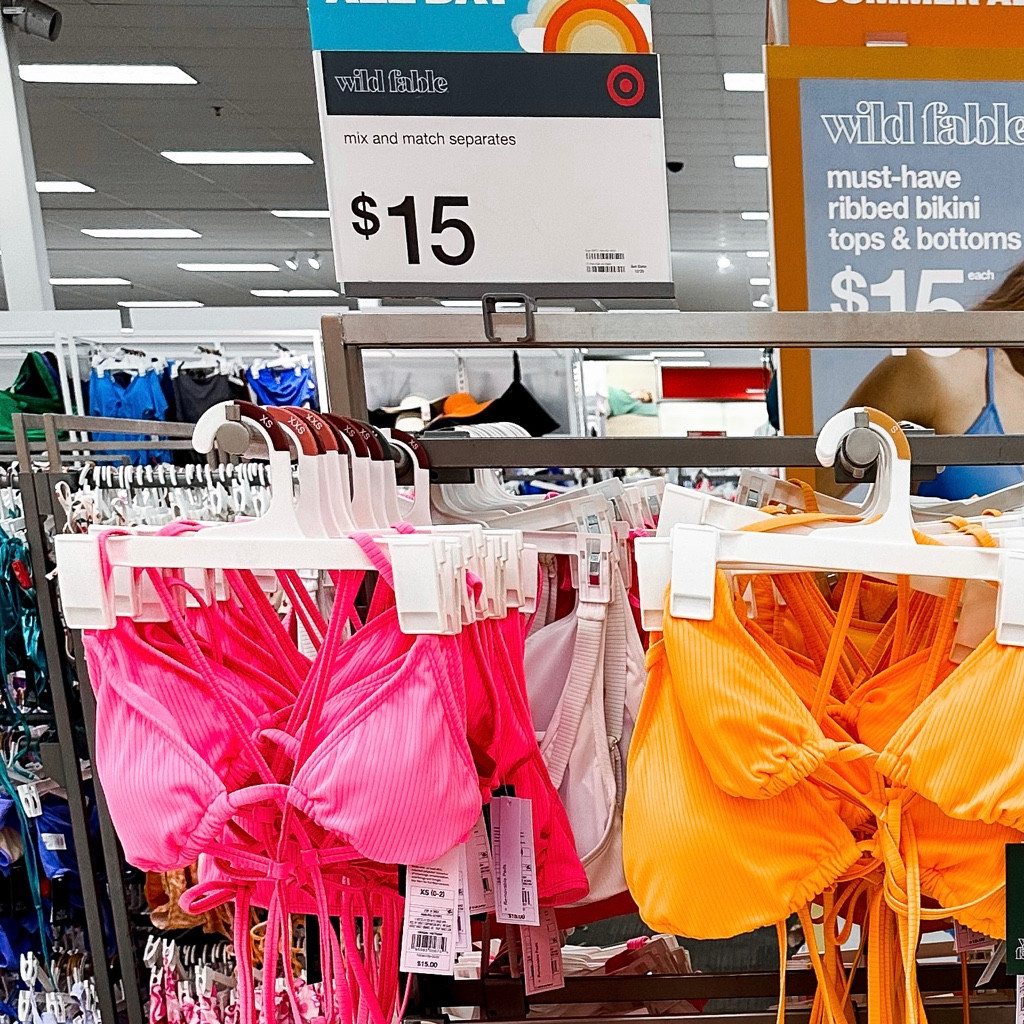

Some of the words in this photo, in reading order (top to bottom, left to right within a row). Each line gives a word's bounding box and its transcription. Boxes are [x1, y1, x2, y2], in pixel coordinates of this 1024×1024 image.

[335, 69, 385, 93] wild
[389, 69, 449, 93] fable
[821, 101, 914, 144] wild
[344, 132, 368, 145] mix
[373, 132, 398, 145] and
[403, 132, 445, 145] match
[449, 133, 516, 147] separates
[827, 164, 962, 188] must-have
[828, 195, 909, 219] ribbed
[915, 195, 980, 219] bikini
[351, 191, 475, 266] $15
[828, 228, 886, 255] tops
[891, 226, 911, 250] &
[917, 226, 1022, 250] bottoms
[967, 269, 995, 280] each
[830, 265, 965, 312] $15
[259, 414, 274, 429] XS
[288, 415, 305, 435] XXS
[306, 413, 323, 431] XXS
[344, 424, 356, 438] XS
[358, 427, 371, 441] XS
[407, 438, 419, 450] XS
[420, 888, 429, 896] XS
[417, 961, 438, 969] $15.00
